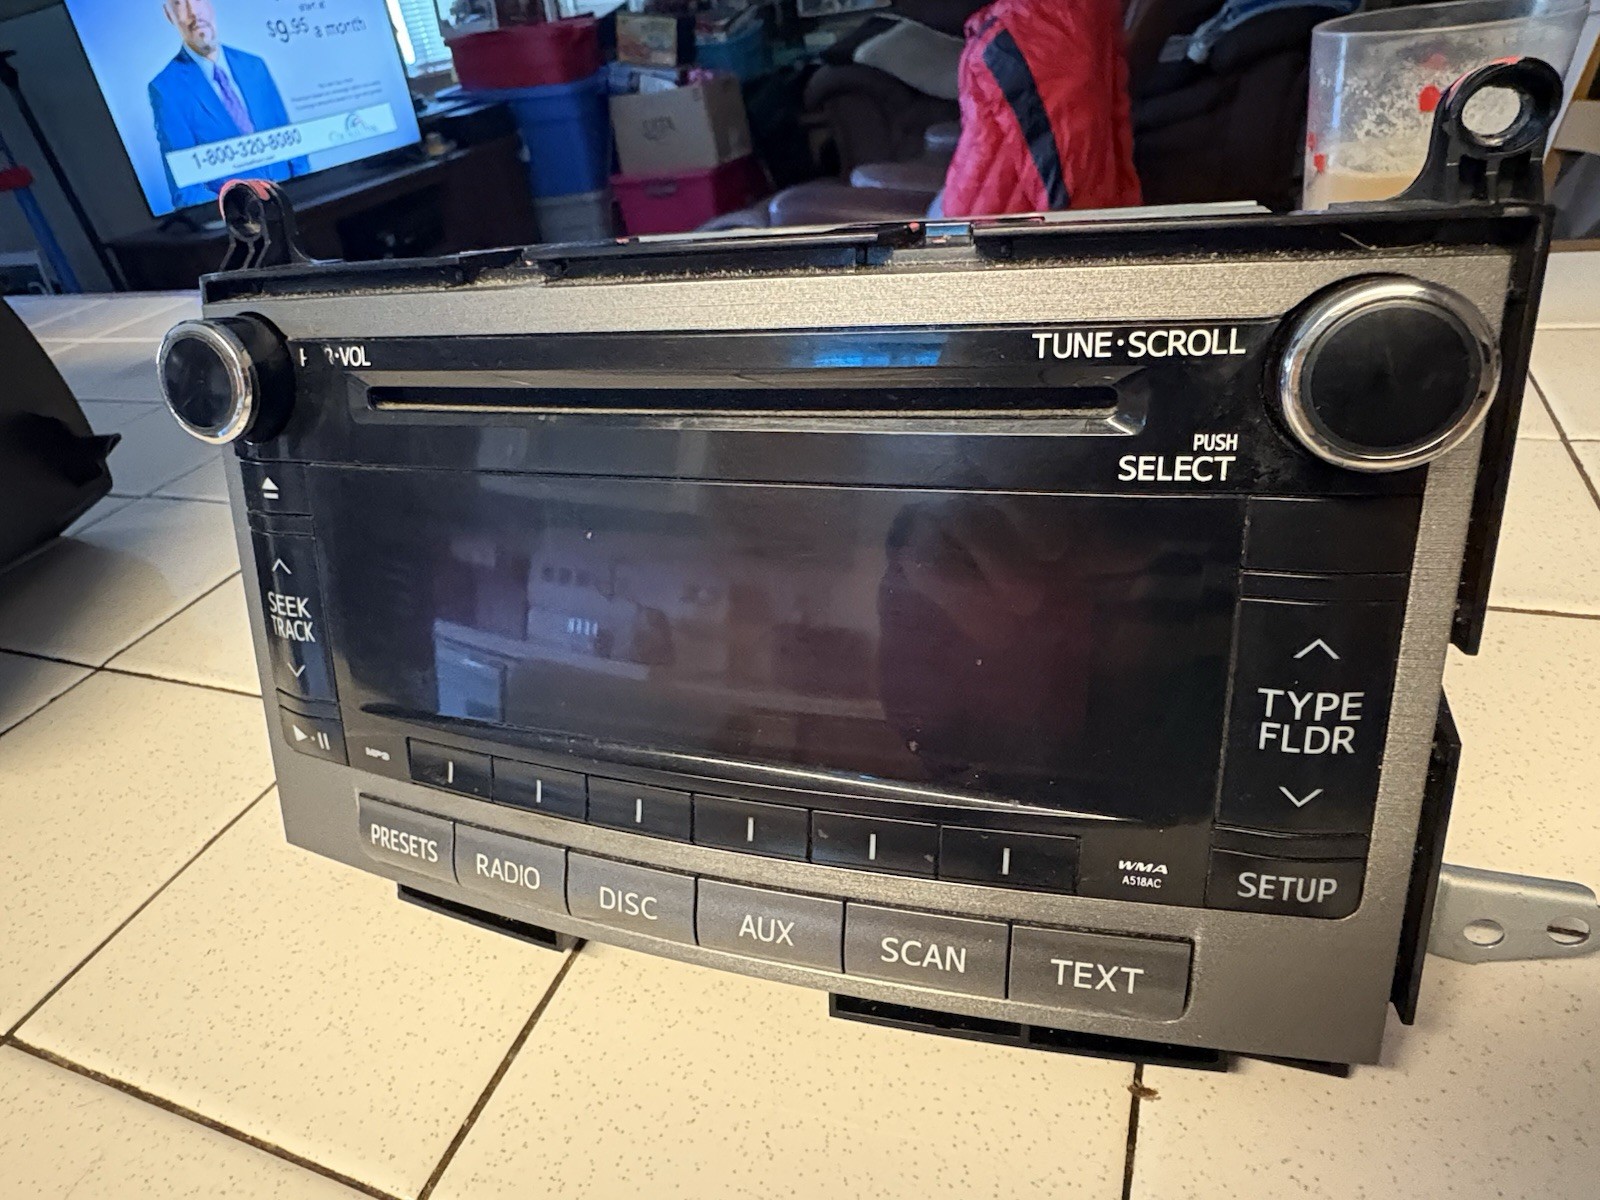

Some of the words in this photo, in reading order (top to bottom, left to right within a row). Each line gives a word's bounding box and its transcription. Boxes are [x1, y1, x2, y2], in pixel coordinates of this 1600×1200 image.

[1193, 433, 1239, 452] PUSH
[1117, 455, 1237, 482] SELECT
[267, 590, 312, 620] SEEK
[270, 614, 316, 643] TRACK
[1257, 687, 1365, 722] TYPE
[1258, 721, 1356, 755] FLDR
[370, 822, 439, 863] PRESETS
[475, 852, 541, 891] RADIO
[1118, 860, 1168, 875] WMA
[1121, 875, 1162, 889] A518AC
[599, 886, 659, 921] DISC
[1236, 871, 1338, 904] SETUP
[738, 914, 796, 948] AUX
[880, 936, 967, 974] SCAN
[1050, 957, 1145, 995] TEXT
